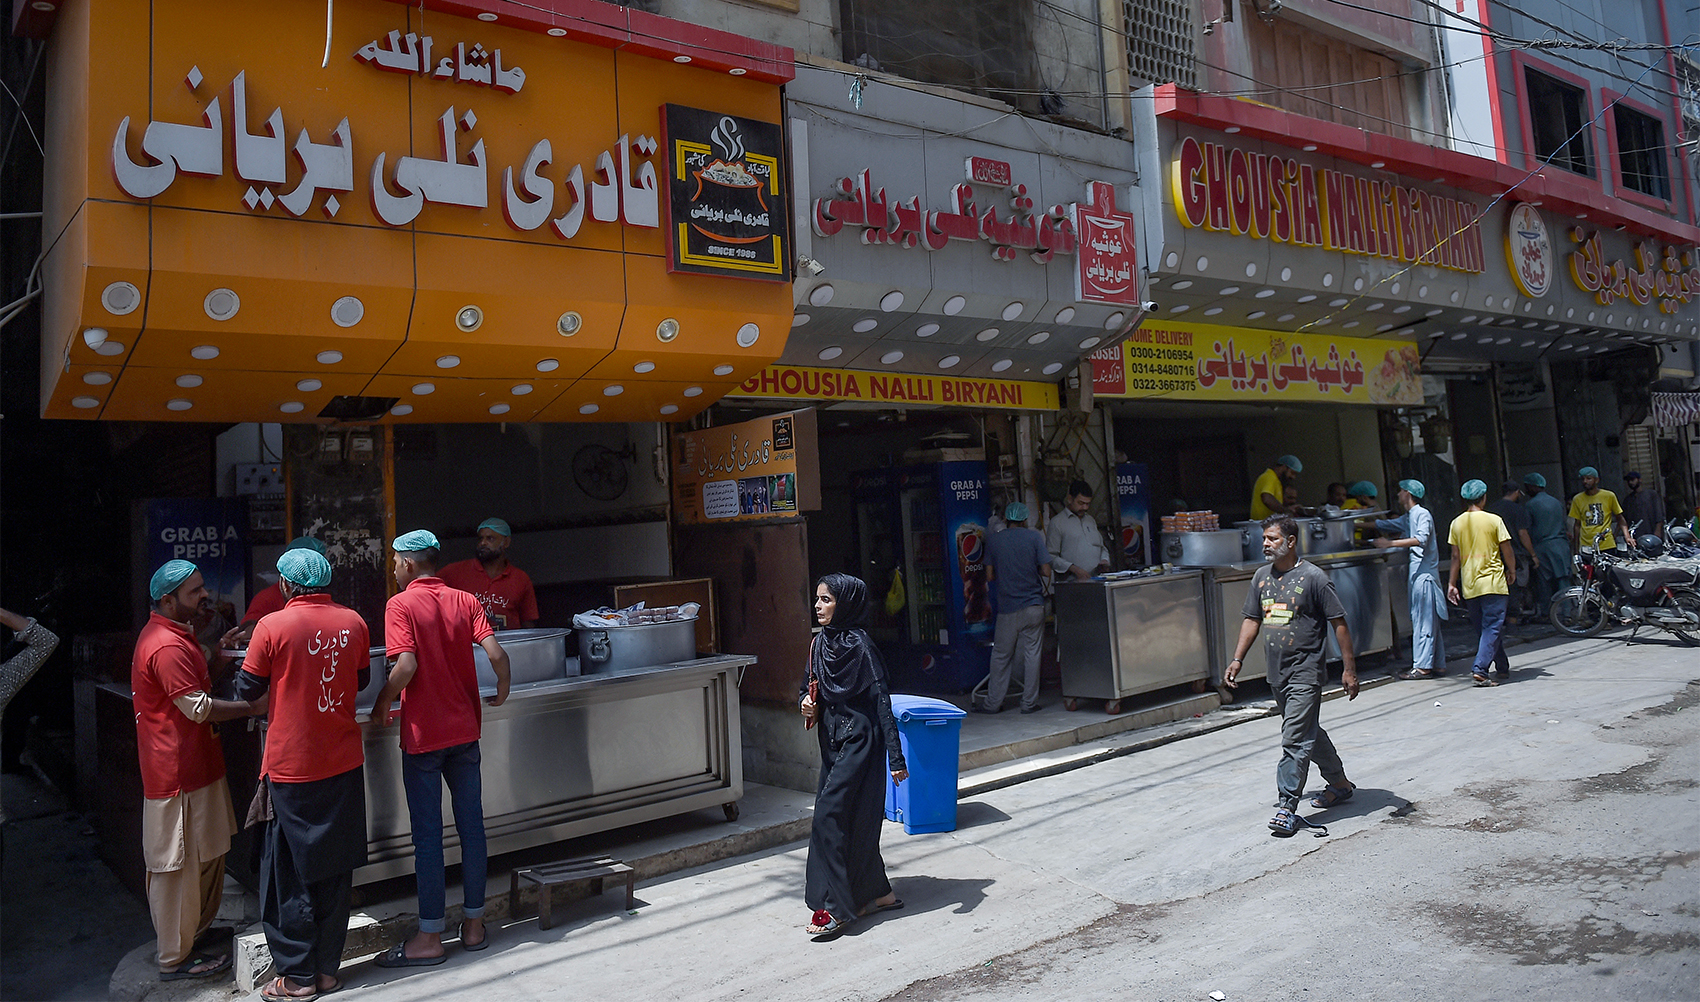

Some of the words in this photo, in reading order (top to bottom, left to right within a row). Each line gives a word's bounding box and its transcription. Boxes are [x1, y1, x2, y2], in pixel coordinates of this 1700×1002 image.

[112, 65, 354, 219] بریانی
[370, 105, 488, 228] نلی
[504, 133, 659, 239] قادری
[690, 203, 724, 221] بریانی
[725, 208, 743, 223] نلی
[743, 212, 770, 228] قادری
[812, 167, 921, 250] بریانی
[920, 183, 979, 250] نلی
[978, 183, 1076, 265] غوثیہ
[707, 244, 735, 257] SINCE
[1091, 230, 1122, 257] غوثیہ
[1086, 257, 1114, 284] بریانی
[1115, 261, 1130, 283] نلی
[1570, 225, 1630, 305] بریانی
[1627, 241, 1656, 306] نلی
[1155, 330, 1193, 346] DELIVERY
[1131, 347, 1193, 361] 0300-2106954
[1197, 337, 1269, 394] بریانی
[1272, 344, 1309, 391] نلی
[1132, 362, 1195, 376] 0314-8480716
[1309, 343, 1365, 393] غوثیہ
[870, 376, 933, 401] NALLI
[941, 380, 1022, 405] BIRYANI
[1133, 378, 1196, 391] 0322-3667375
[698, 437, 724, 477] بریانی
[725, 431, 738, 473] نلی
[737, 439, 771, 472] قادری
[950, 479, 974, 491] GRAB
[975, 482, 982, 490] A
[955, 490, 979, 501] PEPSI
[160, 526, 218, 543] GRAB
[224, 525, 239, 541] A
[173, 542, 227, 559] PEPSI
[307, 629, 351, 656] قادری
